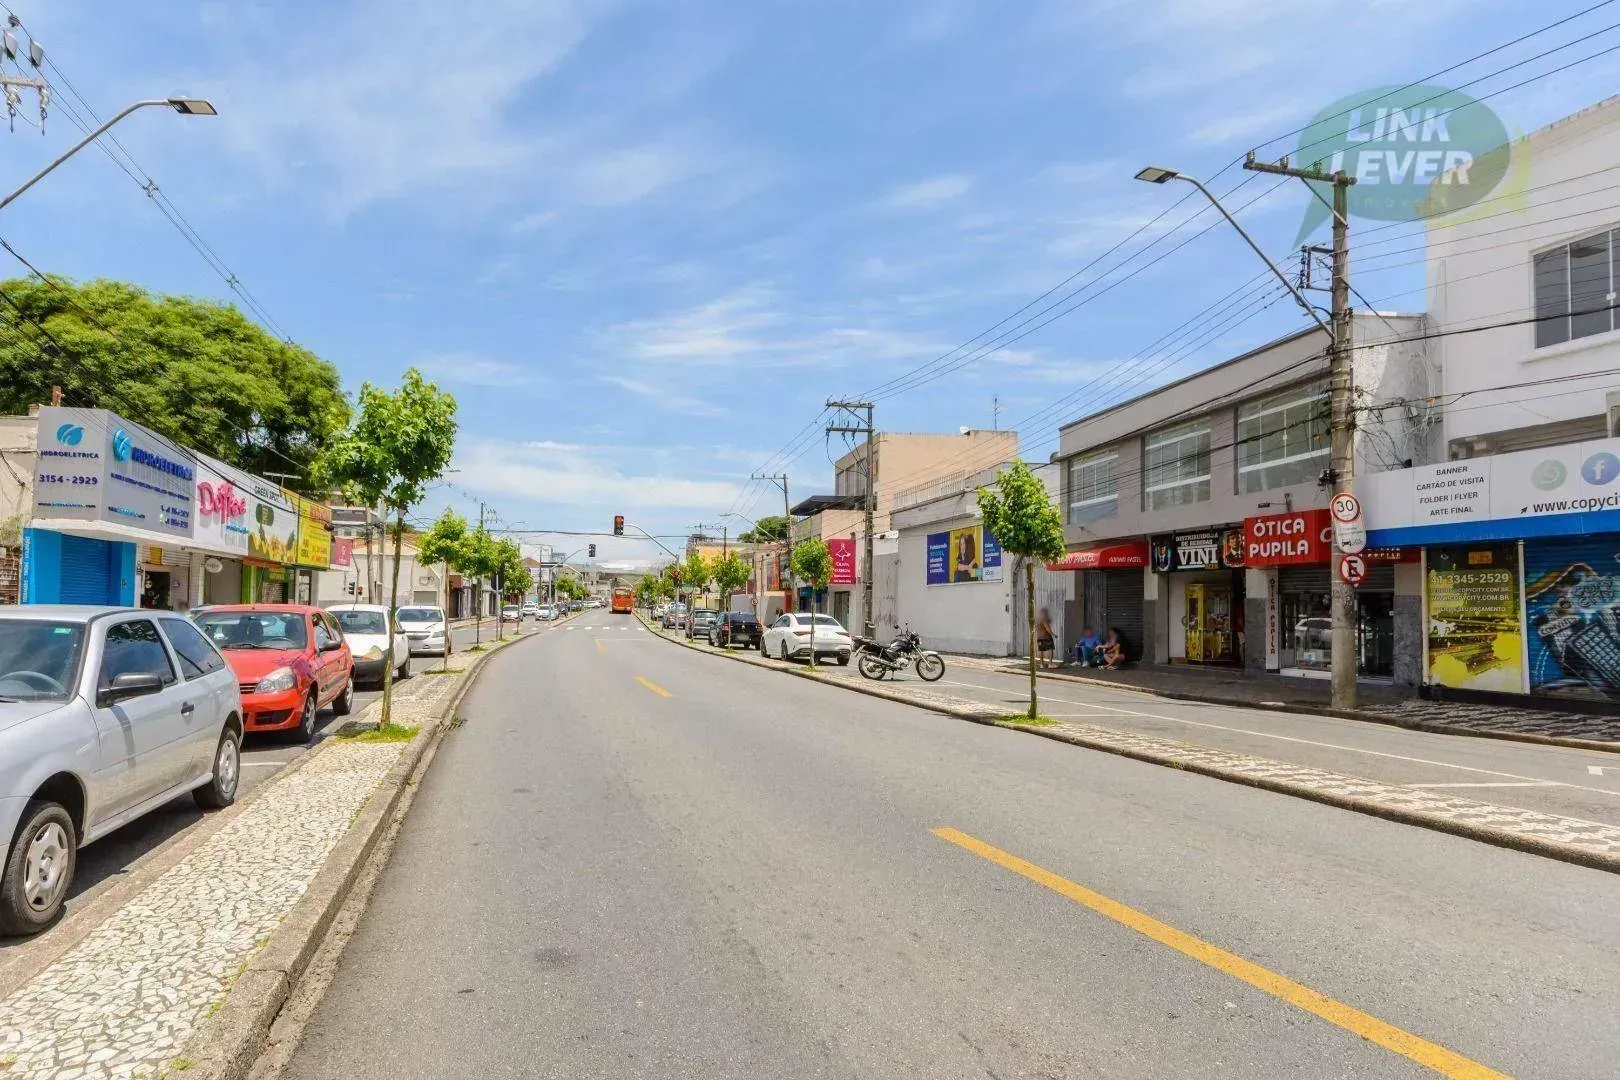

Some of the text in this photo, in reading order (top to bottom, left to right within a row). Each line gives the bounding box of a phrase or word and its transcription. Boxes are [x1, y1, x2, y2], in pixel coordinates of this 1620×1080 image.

[1436, 466, 1468, 476] BANNER
[39, 474, 64, 483] 3154
[72, 475, 98, 485] 2929
[1447, 479, 1457, 487] DE
[1459, 476, 1484, 486] VISITA
[1419, 494, 1449, 504] FOLDER
[1454, 491, 1478, 500] FLYER
[1533, 491, 1620, 513] www.copyci
[1336, 500, 1354, 513] 30
[1430, 506, 1474, 516] ARTE FINAL
[1249, 540, 1309, 558] PUPILA
[1177, 547, 1218, 566] VINI
[1447, 573, 1509, 584] 3345-2529
